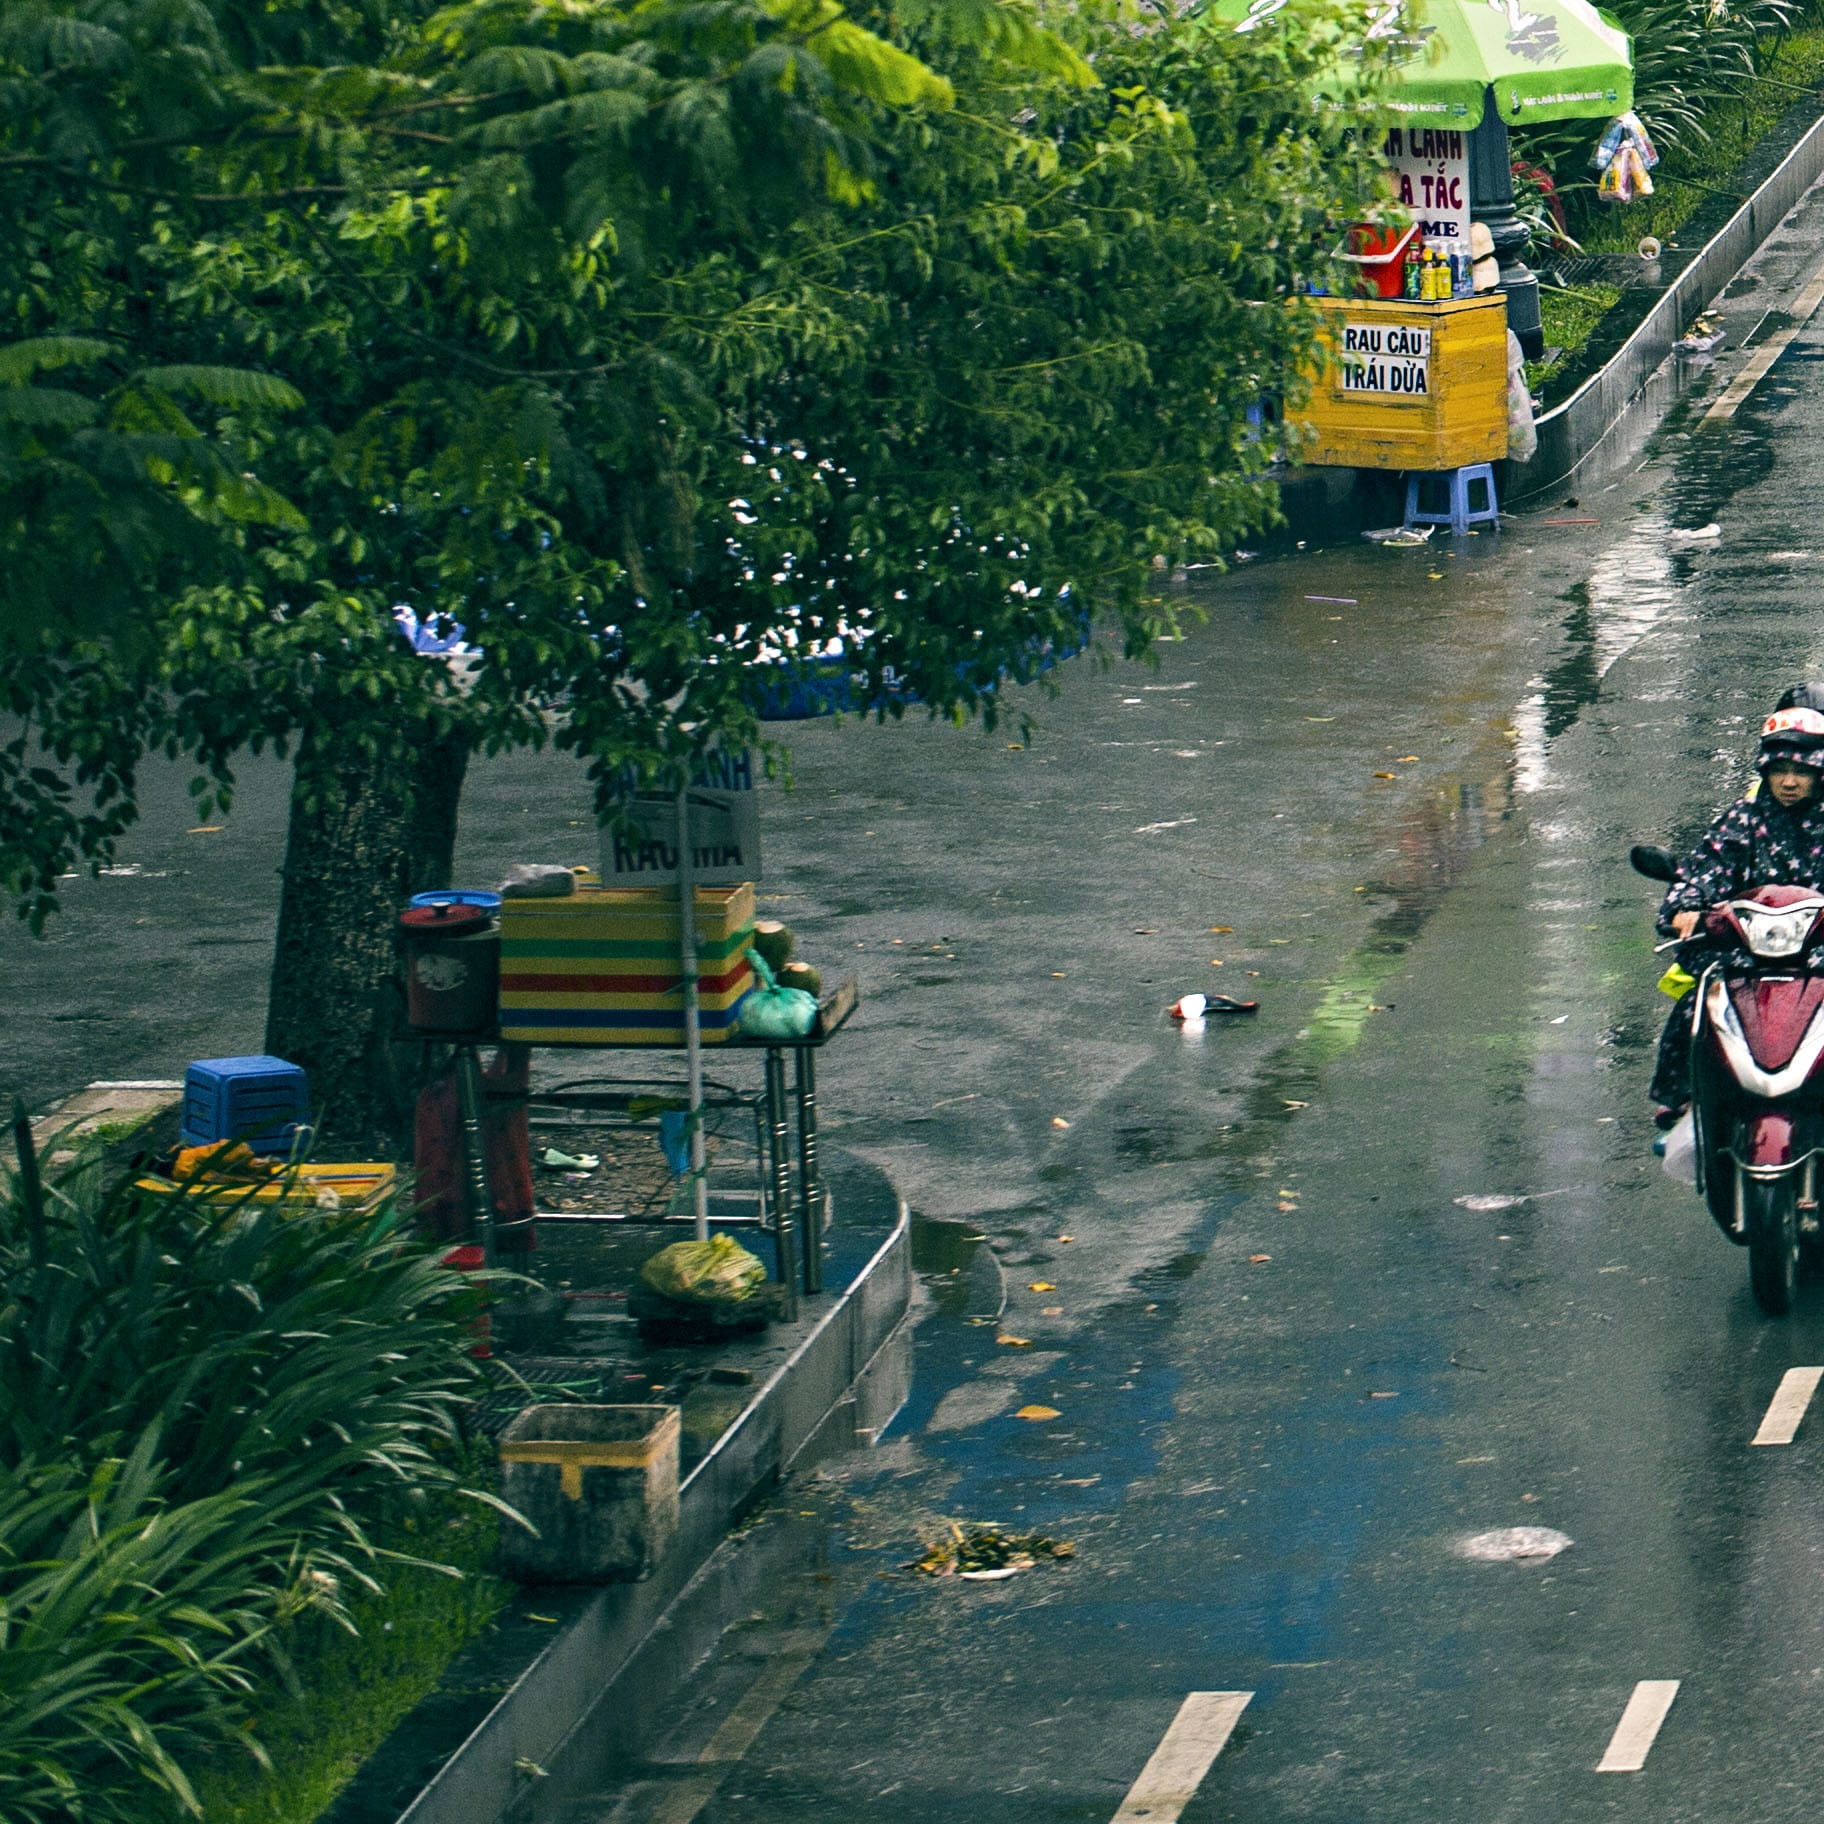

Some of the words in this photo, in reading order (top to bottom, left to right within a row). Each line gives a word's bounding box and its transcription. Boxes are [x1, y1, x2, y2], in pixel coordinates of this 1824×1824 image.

[1420, 161, 1463, 210] TẮC
[1345, 328, 1381, 353] RAU
[1387, 326, 1422, 355] CÂU
[1343, 357, 1385, 390] TRÁI
[1390, 359, 1427, 393] DỪA
